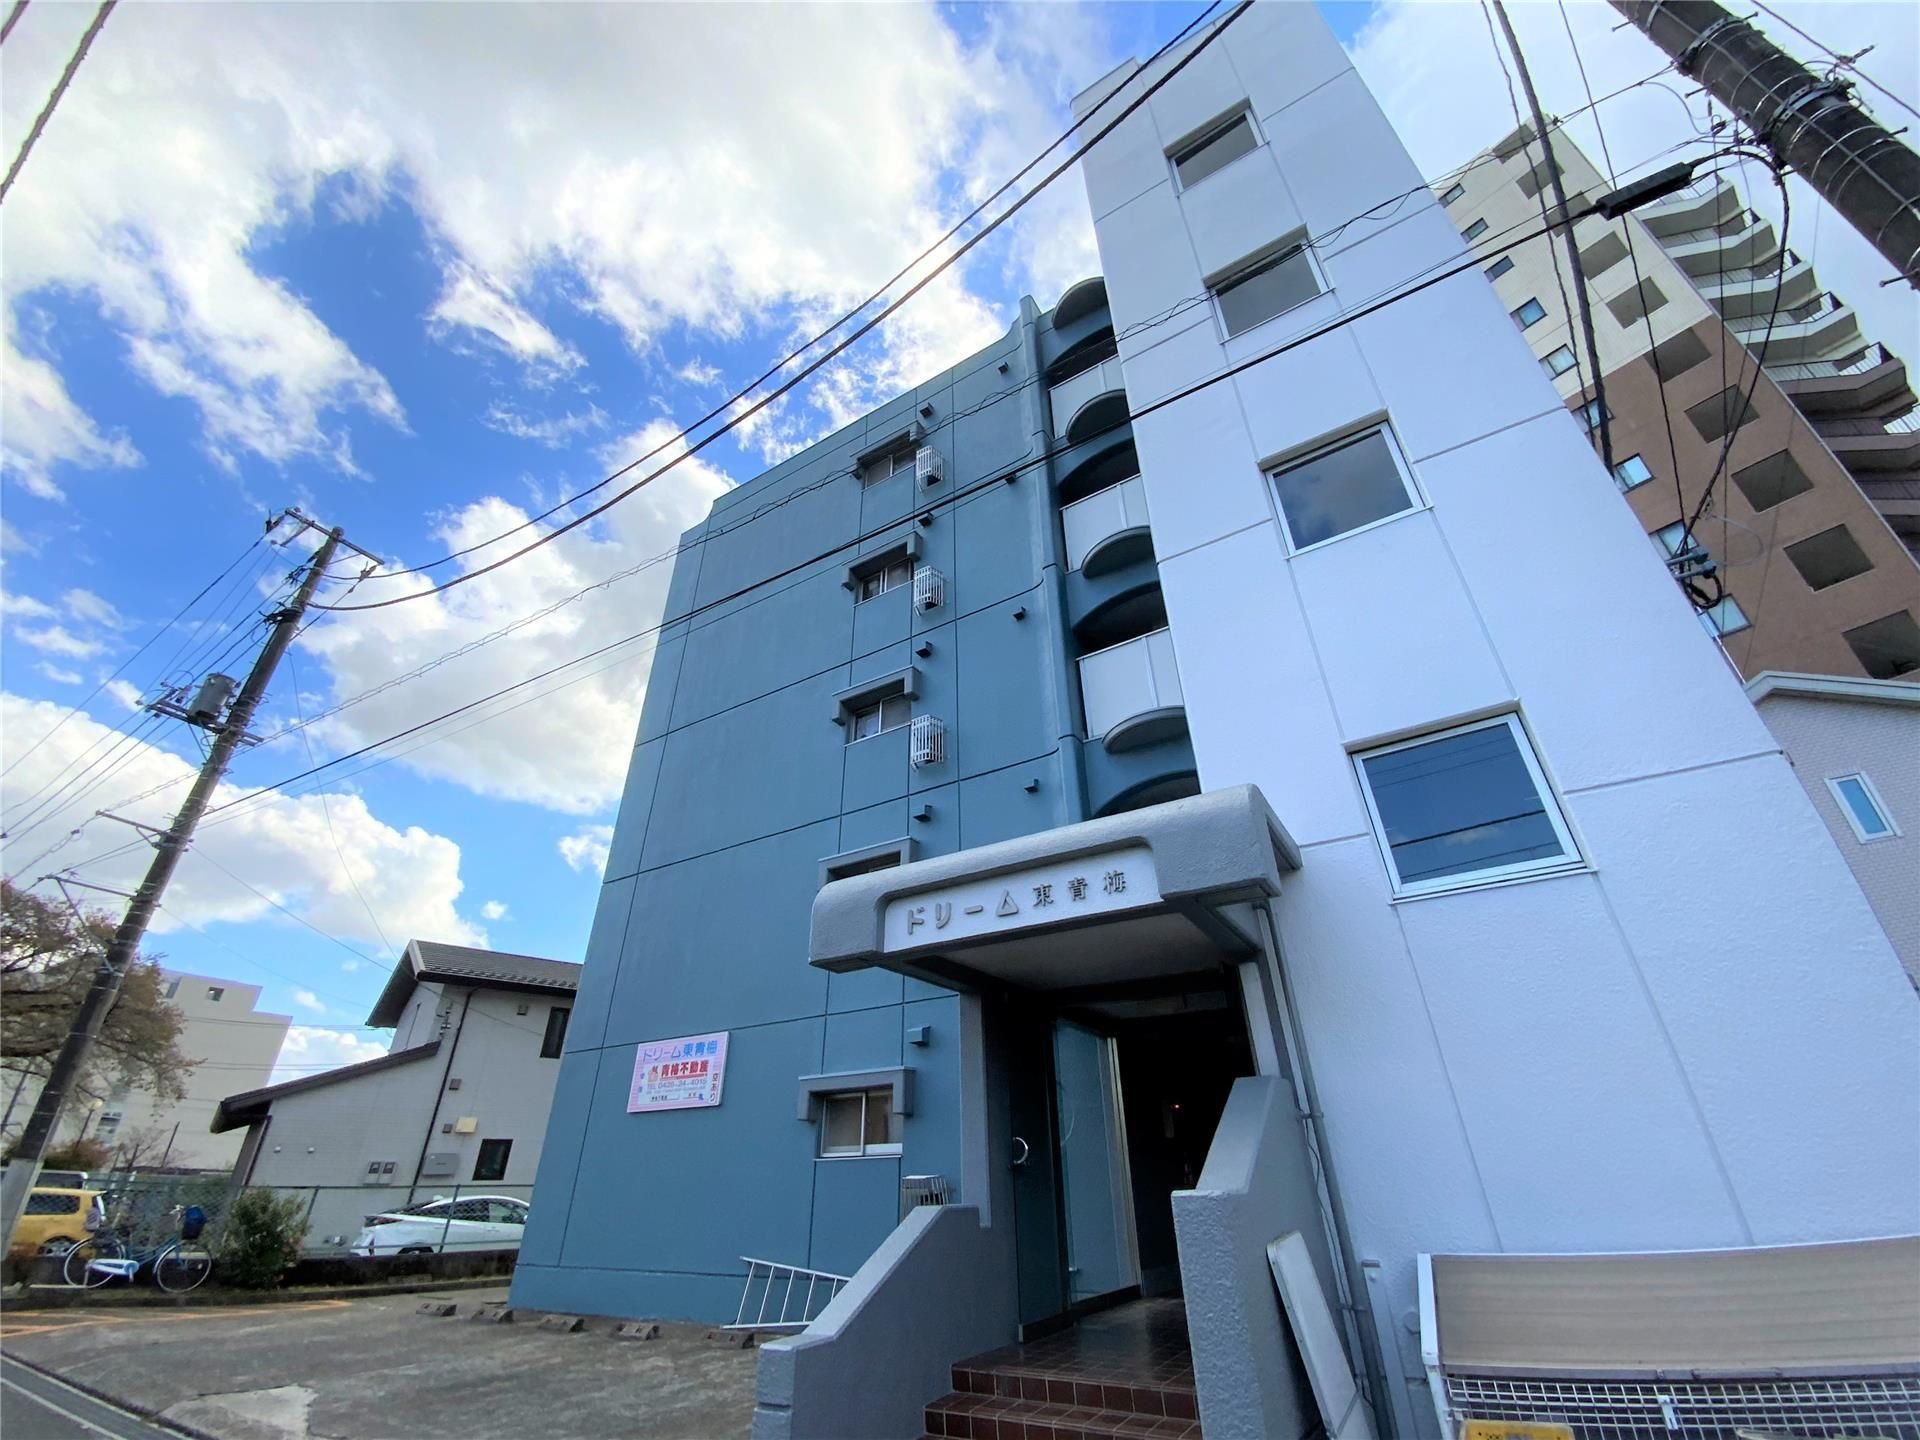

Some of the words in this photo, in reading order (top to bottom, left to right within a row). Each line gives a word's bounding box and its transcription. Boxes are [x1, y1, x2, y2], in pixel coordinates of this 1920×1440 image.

[907, 869, 1127, 935] ドリーム東青梅
[643, 1040, 718, 1062] ドリーム東青梅
[661, 1060, 709, 1077] 青梅不動産
